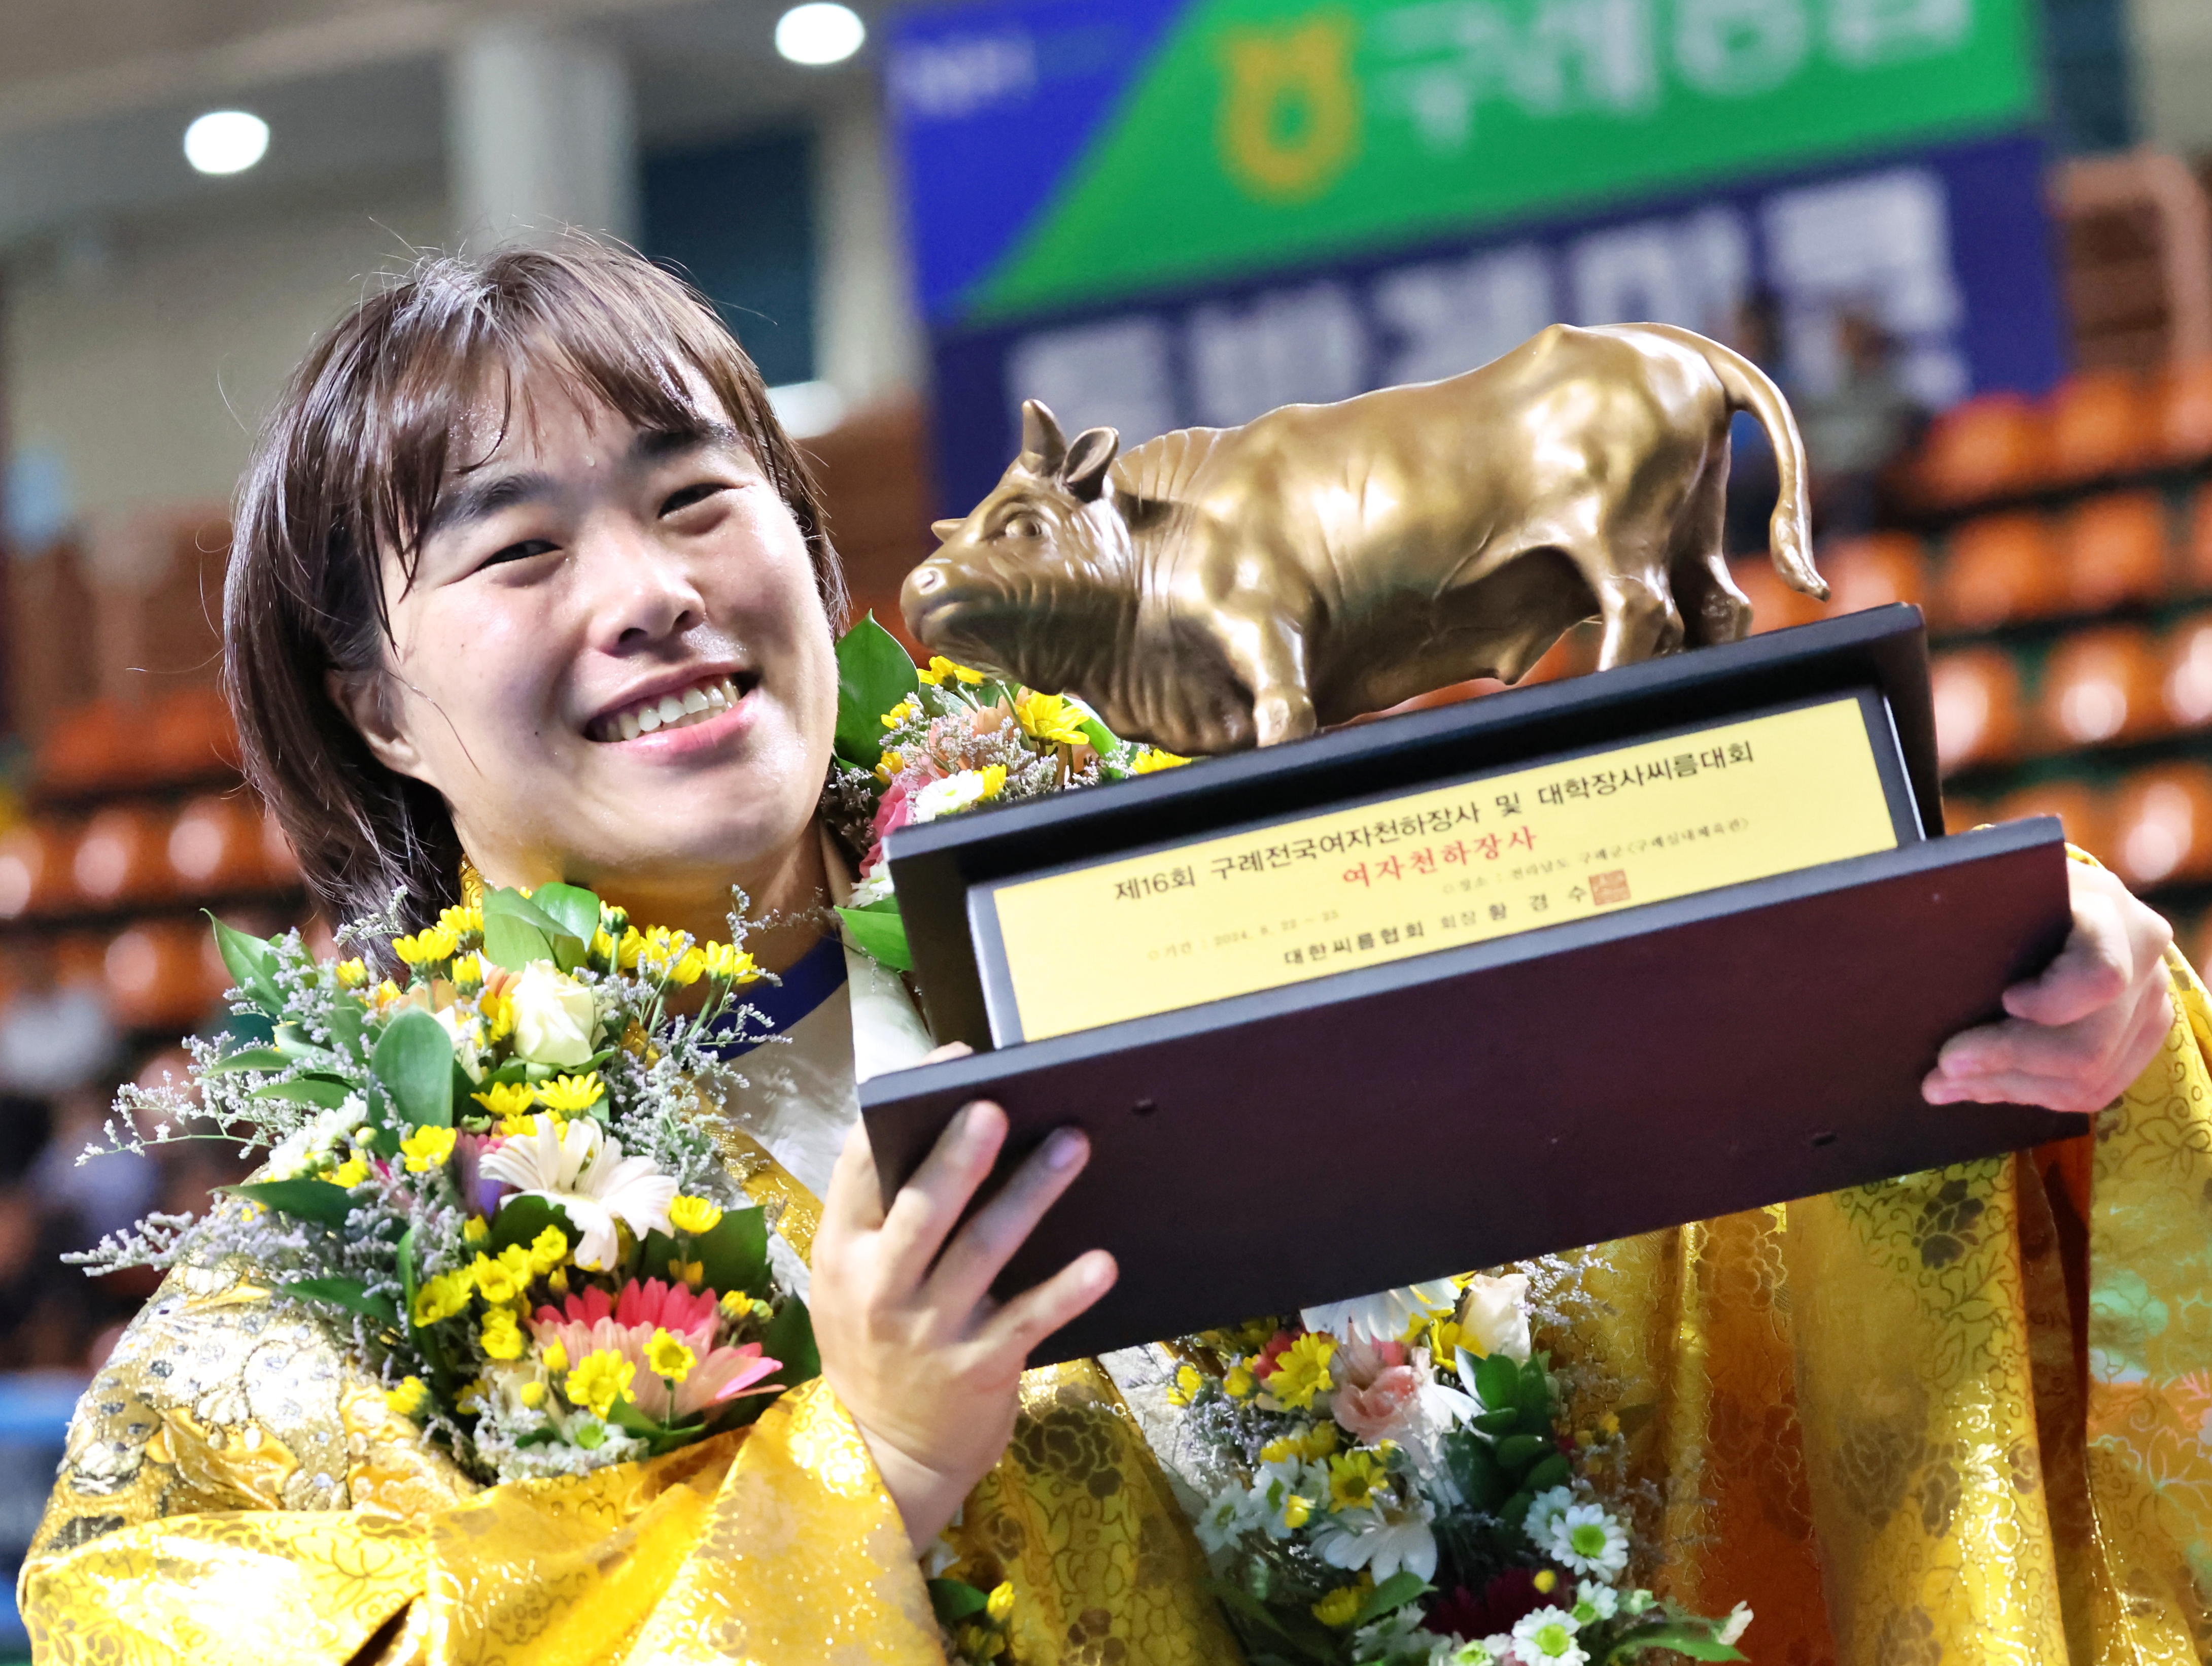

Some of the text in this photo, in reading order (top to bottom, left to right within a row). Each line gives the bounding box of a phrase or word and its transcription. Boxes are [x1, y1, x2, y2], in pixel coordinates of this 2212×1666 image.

[1115, 741, 1753, 899] 제16회 구례전국여자천하장사 및 대학장사씨름대회
[1343, 826, 1535, 887] 여자천하장사
[1285, 922, 1424, 964] 대한씨름협회
[1570, 886, 1584, 902] 수
